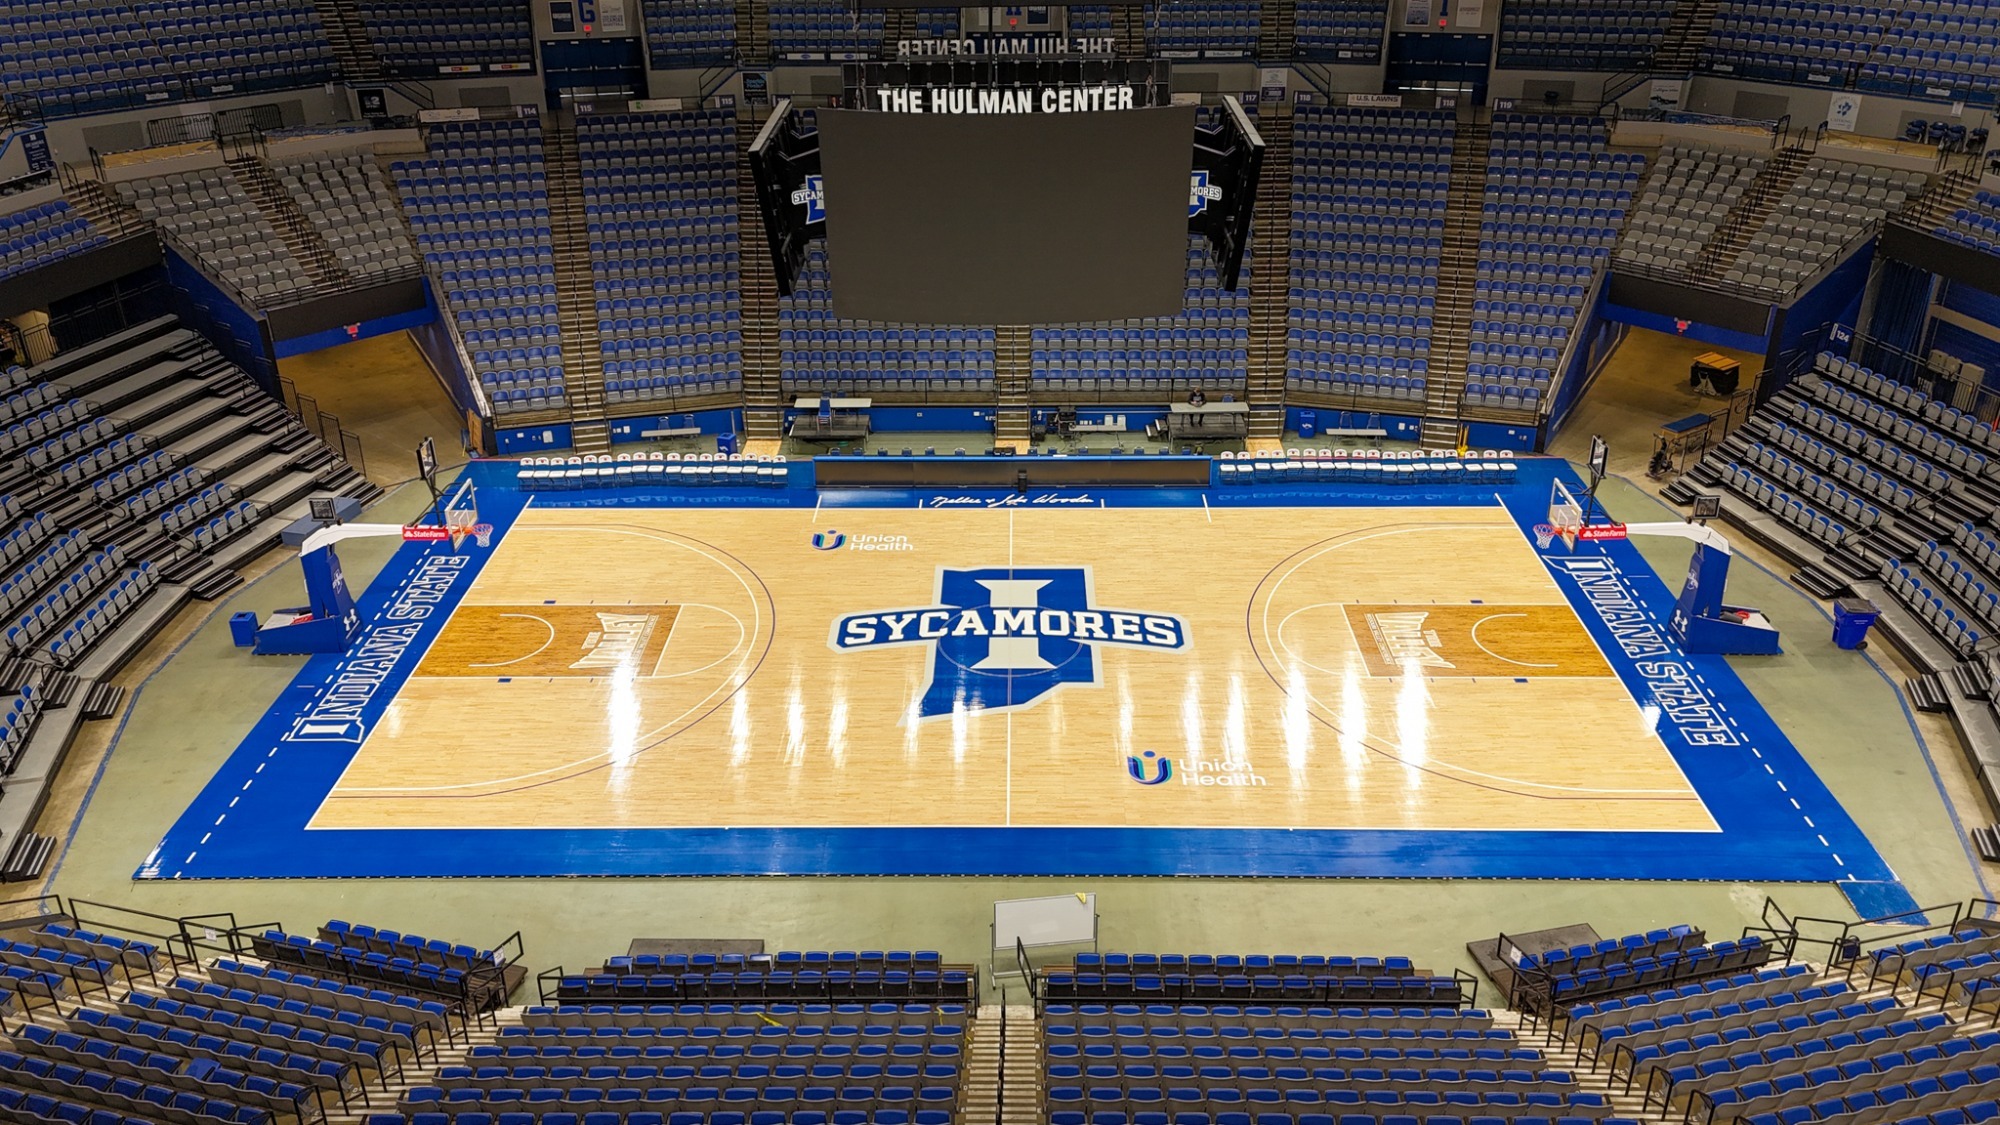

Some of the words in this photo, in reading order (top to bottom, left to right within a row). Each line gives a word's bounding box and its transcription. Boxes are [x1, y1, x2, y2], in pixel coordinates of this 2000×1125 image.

[721, 97, 733, 105] 115
[877, 88, 923, 114] THE
[931, 87, 1032, 114] HULMAN
[1041, 85, 1134, 114] CENTER
[1245, 94, 1257, 102] 117
[1299, 94, 1311, 102] 118
[1356, 94, 1370, 102] U.S.
[1371, 94, 1399, 103] LAWNS
[1442, 99, 1455, 107] 118
[1500, 101, 1512, 109] 119
[523, 107, 537, 115] 114
[580, 104, 593, 113] 115
[794, 190, 824, 202] SYCAM
[1190, 186, 1220, 198] MORES
[1837, 330, 1850, 342] 124
[413, 530, 446, 538] StateFarm
[1593, 529, 1626, 538] StateFarm
[852, 534, 907, 543] Union
[850, 542, 914, 551] Health
[843, 607, 1180, 648] SYCAMORES
[287, 622, 423, 744] INDIANA
[386, 555, 471, 622] STATE
[1542, 554, 1671, 660] INDIANA
[1635, 659, 1742, 748] STATE
[1179, 758, 1254, 772] Union
[1181, 772, 1267, 786] Health
